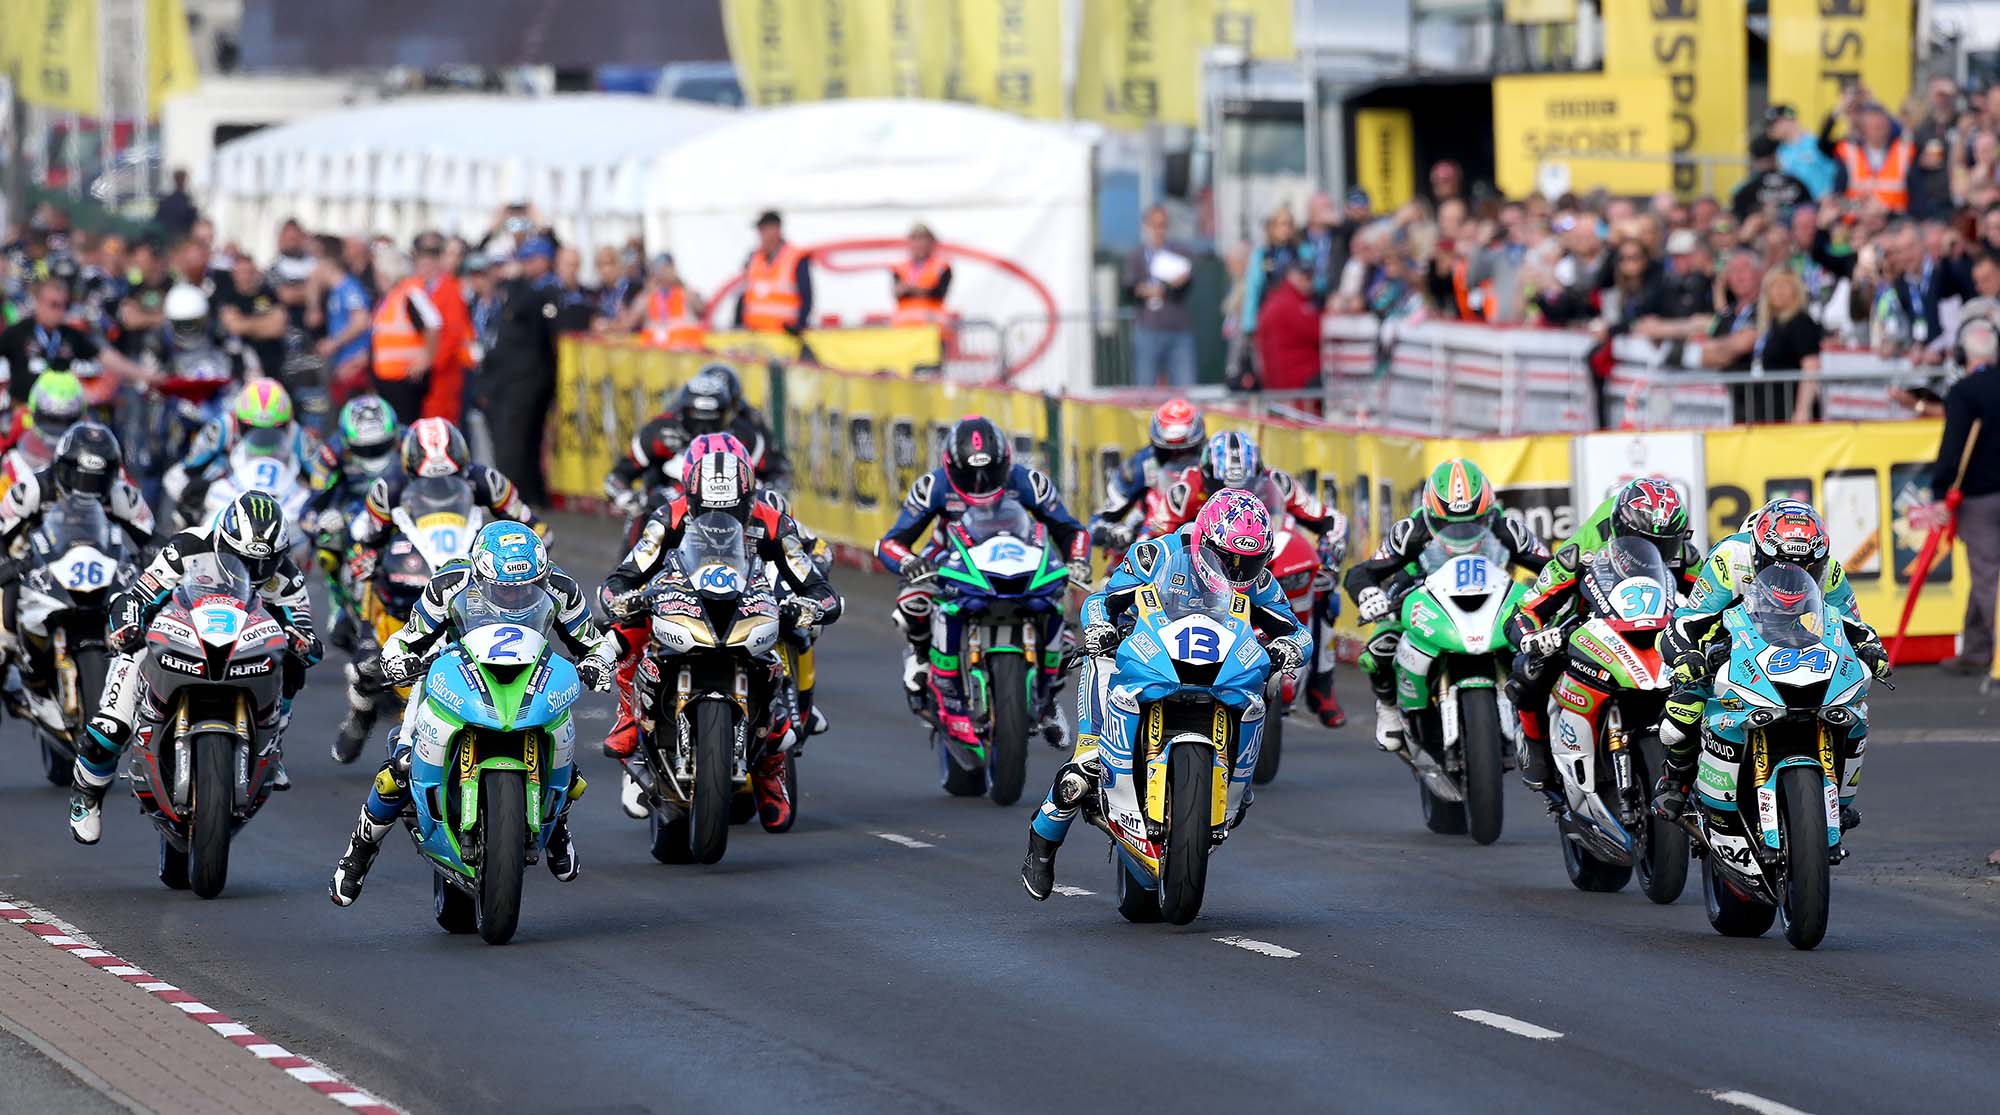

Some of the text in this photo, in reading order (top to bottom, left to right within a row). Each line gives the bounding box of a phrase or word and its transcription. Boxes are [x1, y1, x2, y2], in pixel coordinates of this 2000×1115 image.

[255, 463, 278, 487] 9
[252, 543, 268, 552] Arai
[431, 529, 457, 553] 10
[988, 543, 1025, 562] 12
[1236, 538, 1257, 548] Arai
[69, 561, 104, 587] 36
[507, 564, 528, 572] SHOEI
[701, 566, 738, 590] 666
[1456, 559, 1487, 589] 86
[656, 591, 698, 605] SMITHS
[1168, 586, 1189, 597] MOTUL
[1590, 585, 1611, 614] OXFORD
[1621, 585, 1662, 618] 37
[201, 609, 236, 635] 3
[488, 626, 524, 659] 2
[1174, 626, 1220, 663] 13
[1578, 635, 1613, 663] QUATTRO
[161, 656, 203, 675] HUNTS
[230, 657, 271, 676] HUNTS
[1571, 659, 1597, 678] WICKED
[1614, 644, 1649, 684] Speedfit
[1743, 659, 1756, 676] EHA
[1767, 647, 1831, 675] 34
[1840, 660, 1849, 677] EHA
[429, 671, 465, 709] Silicone
[547, 682, 578, 713] Silicone
[1706, 732, 1735, 760] Group
[1120, 812, 1142, 829] SMT
